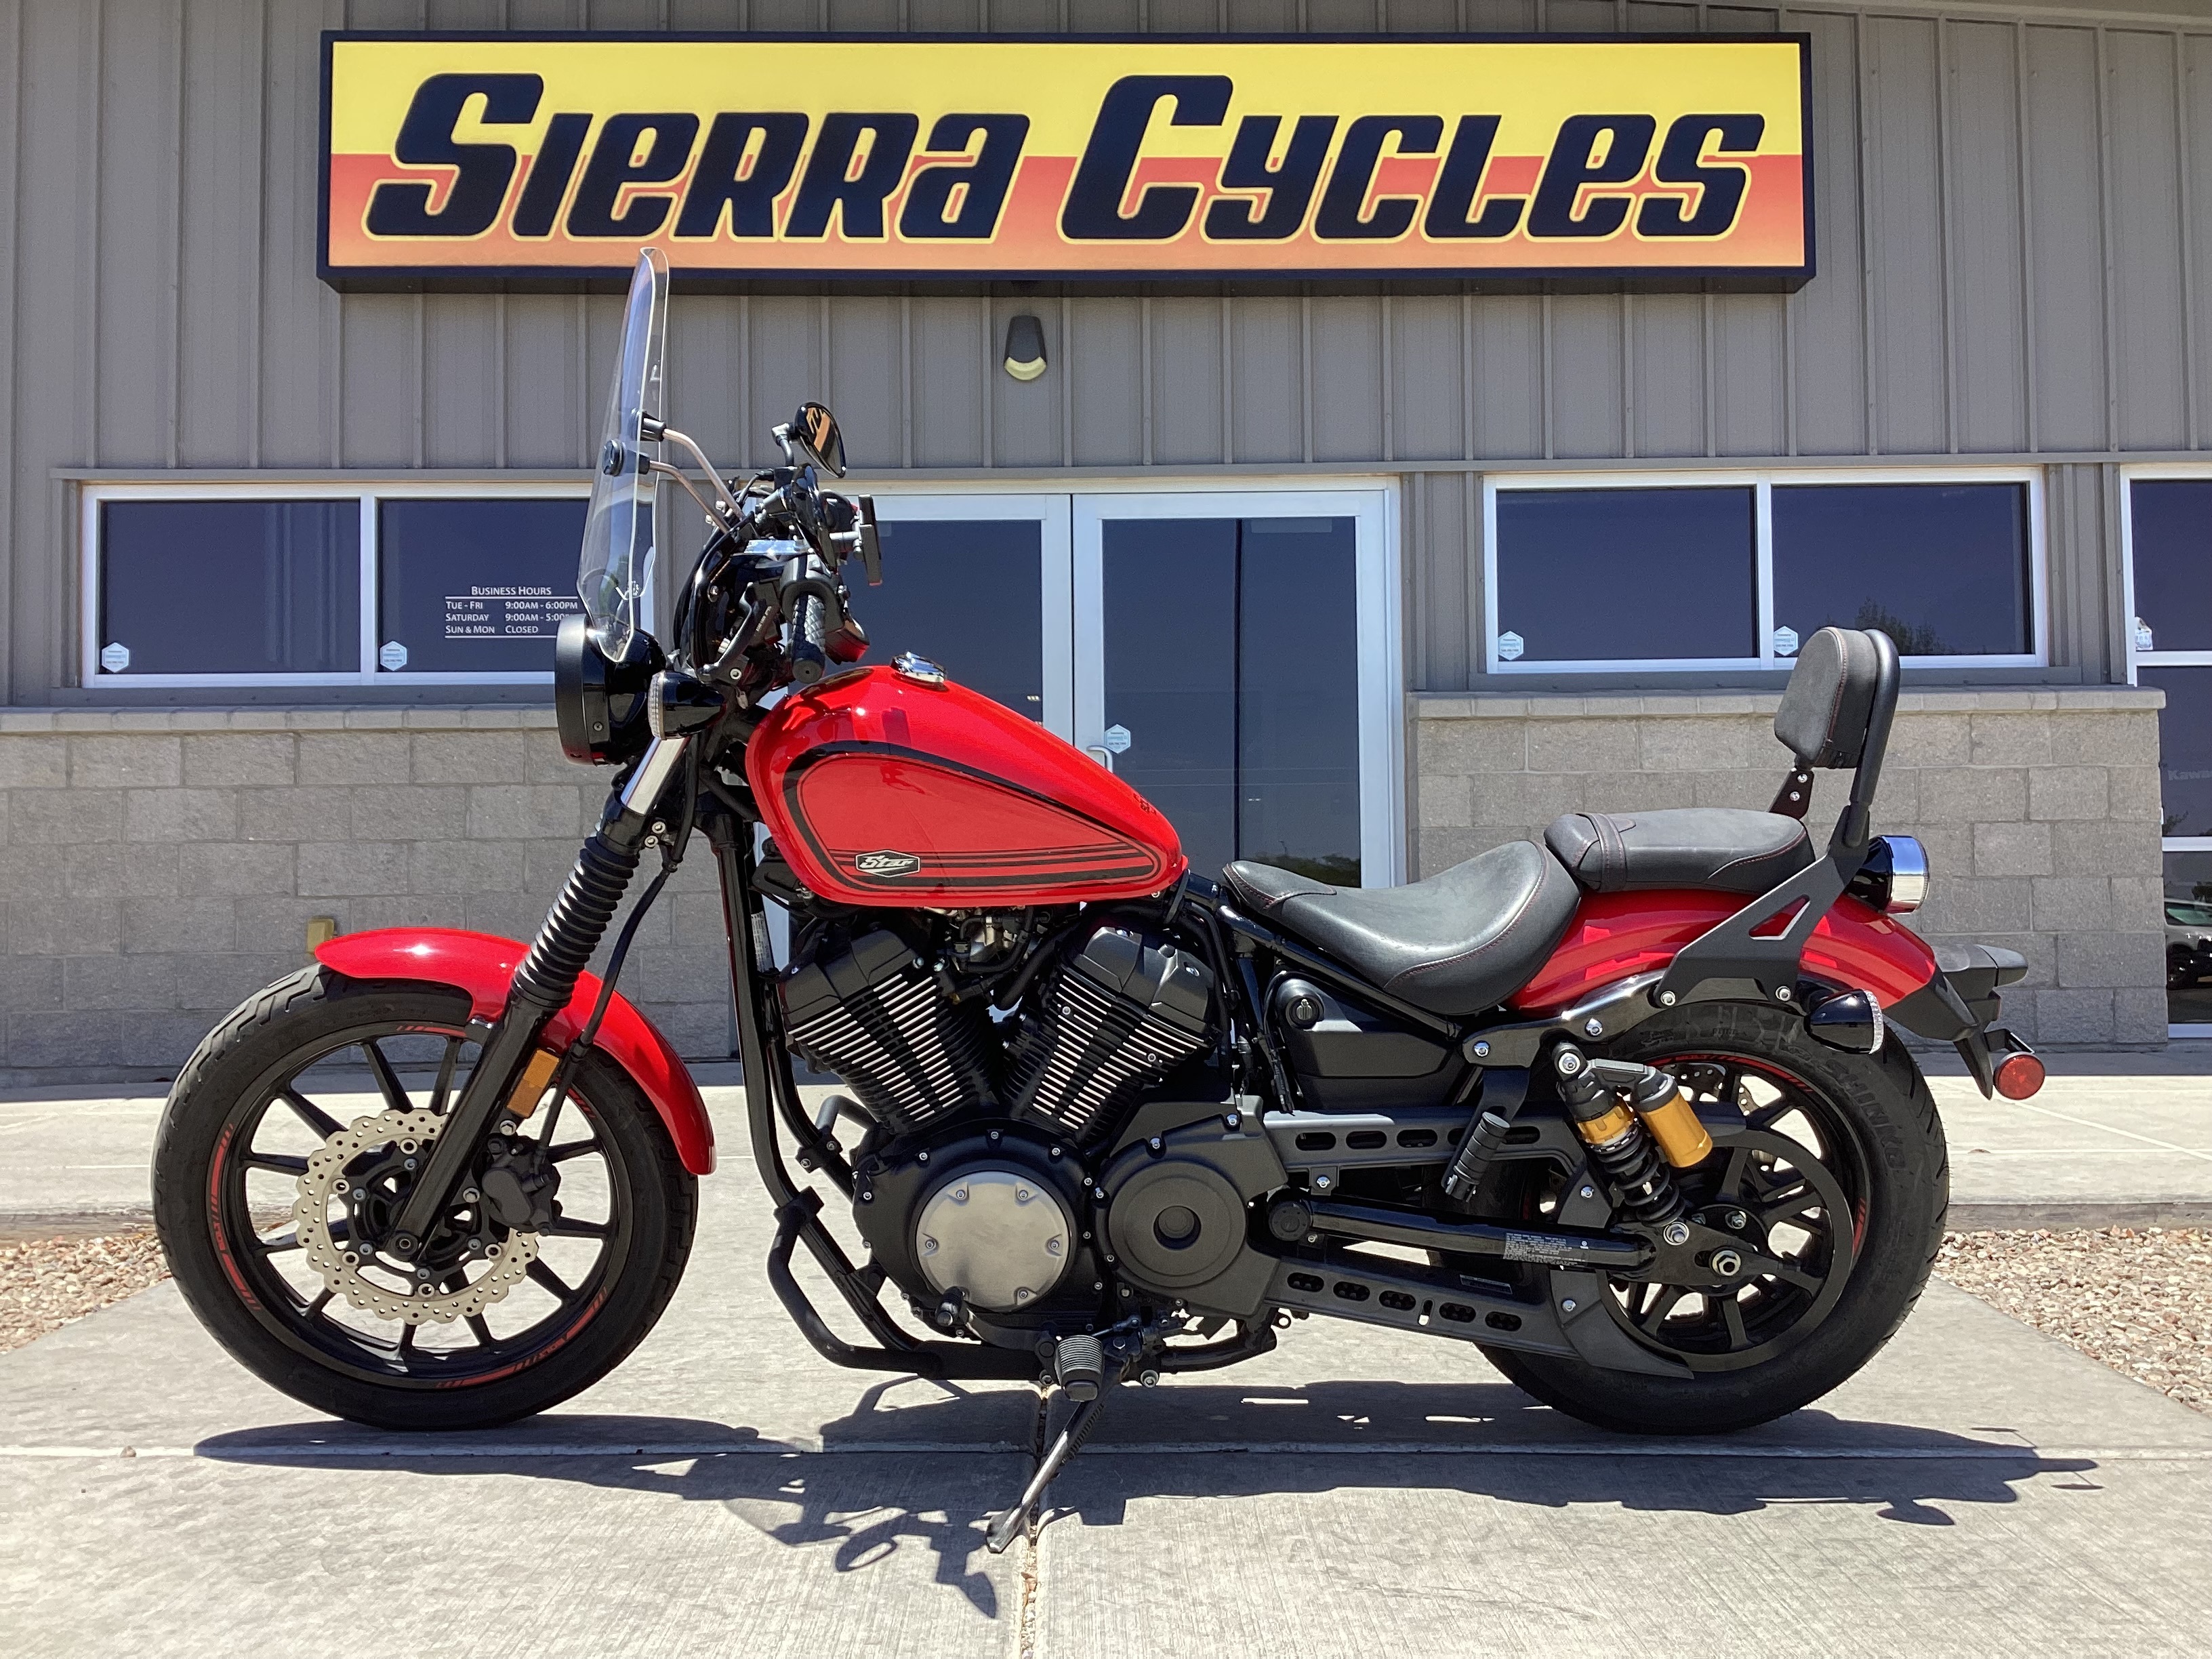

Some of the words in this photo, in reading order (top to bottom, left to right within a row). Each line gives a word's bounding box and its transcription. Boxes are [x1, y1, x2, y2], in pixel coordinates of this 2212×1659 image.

[505, 601, 539, 610] 9:00AM
[545, 601, 578, 610] 6:00PM
[505, 613, 539, 621] 9:00AM
[465, 626, 472, 634] &
[859, 855, 914, 869] Star
